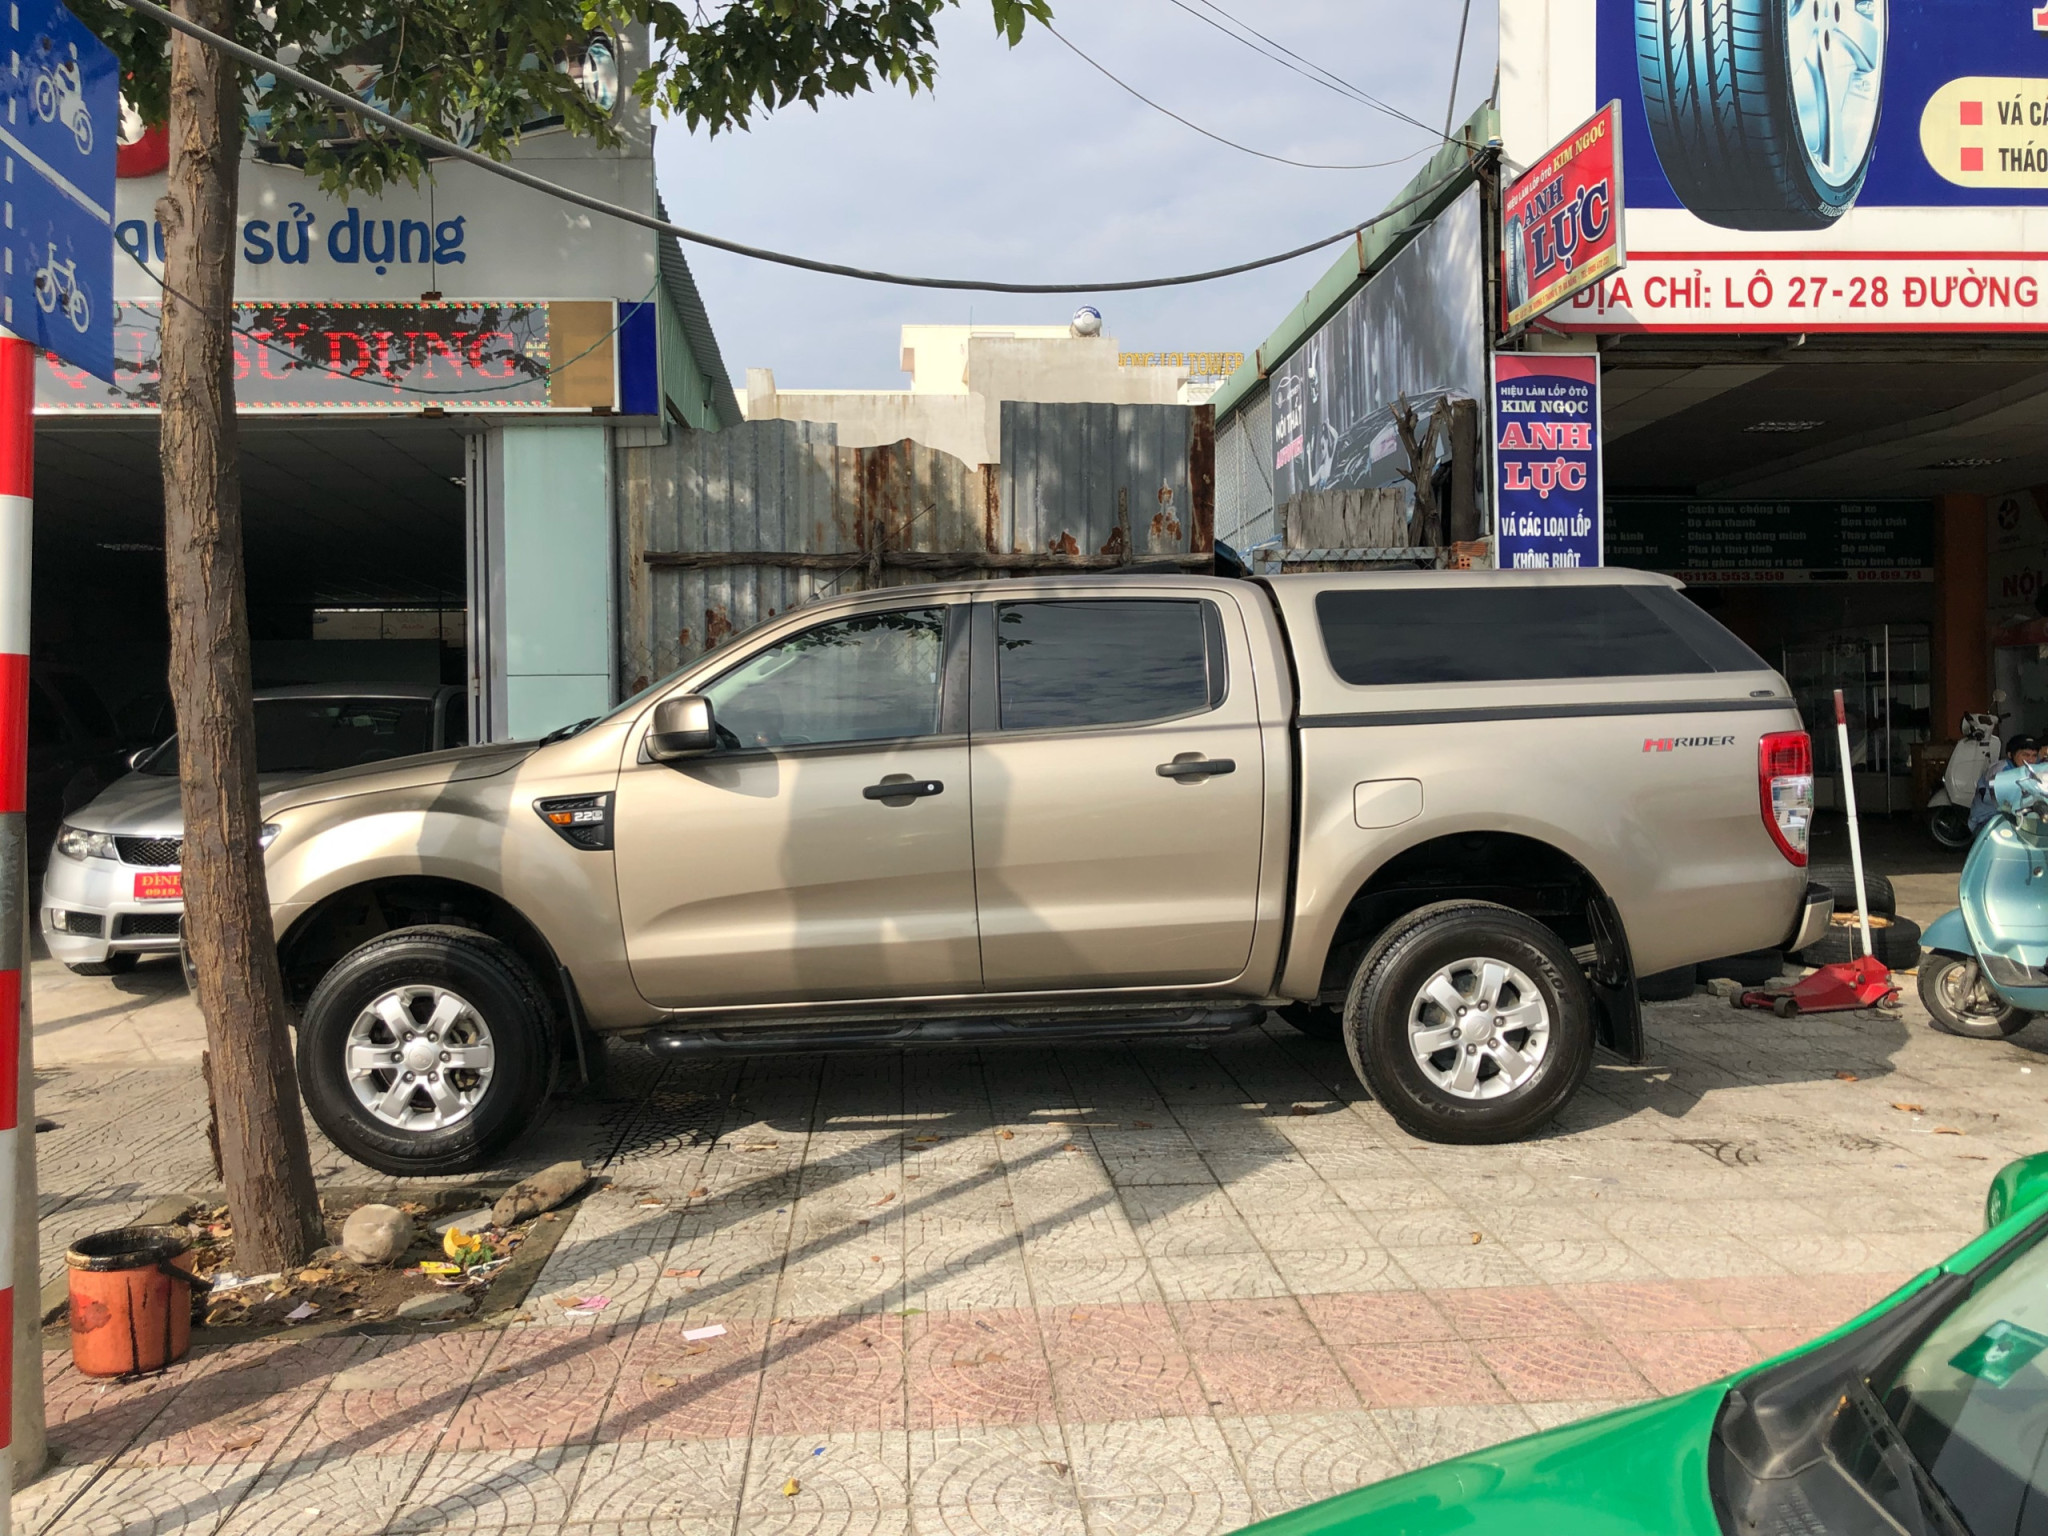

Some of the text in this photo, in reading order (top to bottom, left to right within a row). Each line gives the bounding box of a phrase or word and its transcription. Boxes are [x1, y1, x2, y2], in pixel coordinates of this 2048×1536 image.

[1998, 94, 2024, 127] VÁ
[1518, 186, 1529, 201] LÀM
[1529, 174, 1540, 192] LỐP
[1553, 145, 1573, 173] KIM
[1575, 120, 1605, 155] NGỌC
[1998, 141, 2048, 173] THÁO
[1523, 174, 1564, 231] ANH
[243, 201, 315, 265] sử
[328, 207, 467, 276] dụng
[1532, 178, 1609, 279] LỰC
[1572, 277, 1634, 315] ĐỊA
[1644, 268, 1711, 309] CHỈ:
[1725, 268, 1774, 309] LÔ
[1902, 267, 2039, 308] ĐƯỜNG
[324, 331, 515, 394] DỤNG
[1187, 351, 1245, 376] TOWER
[1500, 383, 1588, 397] HIỆU LÀM LỐP ÔTÔ
[1501, 400, 1588, 417] KIM NGỌC
[1499, 422, 1592, 451] ANH
[1504, 456, 1587, 500] LỰC
[1501, 508, 1591, 542] VÁ CÁC LOẠI LỐP
[1513, 548, 1549, 568] KHÔNG
